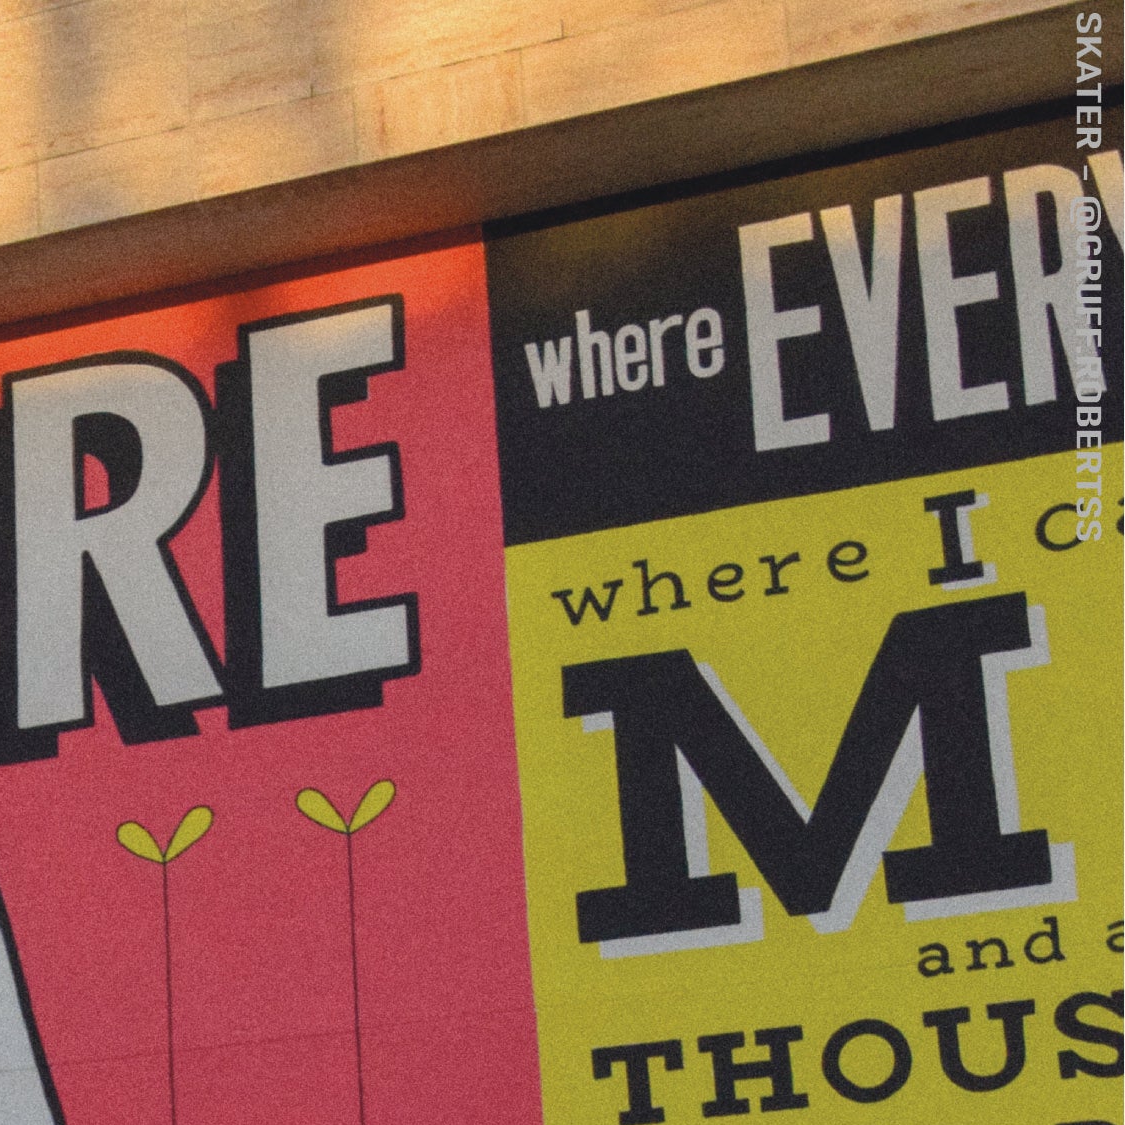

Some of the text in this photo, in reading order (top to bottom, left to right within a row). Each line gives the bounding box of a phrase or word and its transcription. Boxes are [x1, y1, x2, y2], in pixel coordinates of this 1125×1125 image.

[525, 308, 725, 408] where
[552, 489, 1124, 626] where I c
[917, 916, 1066, 978] and
